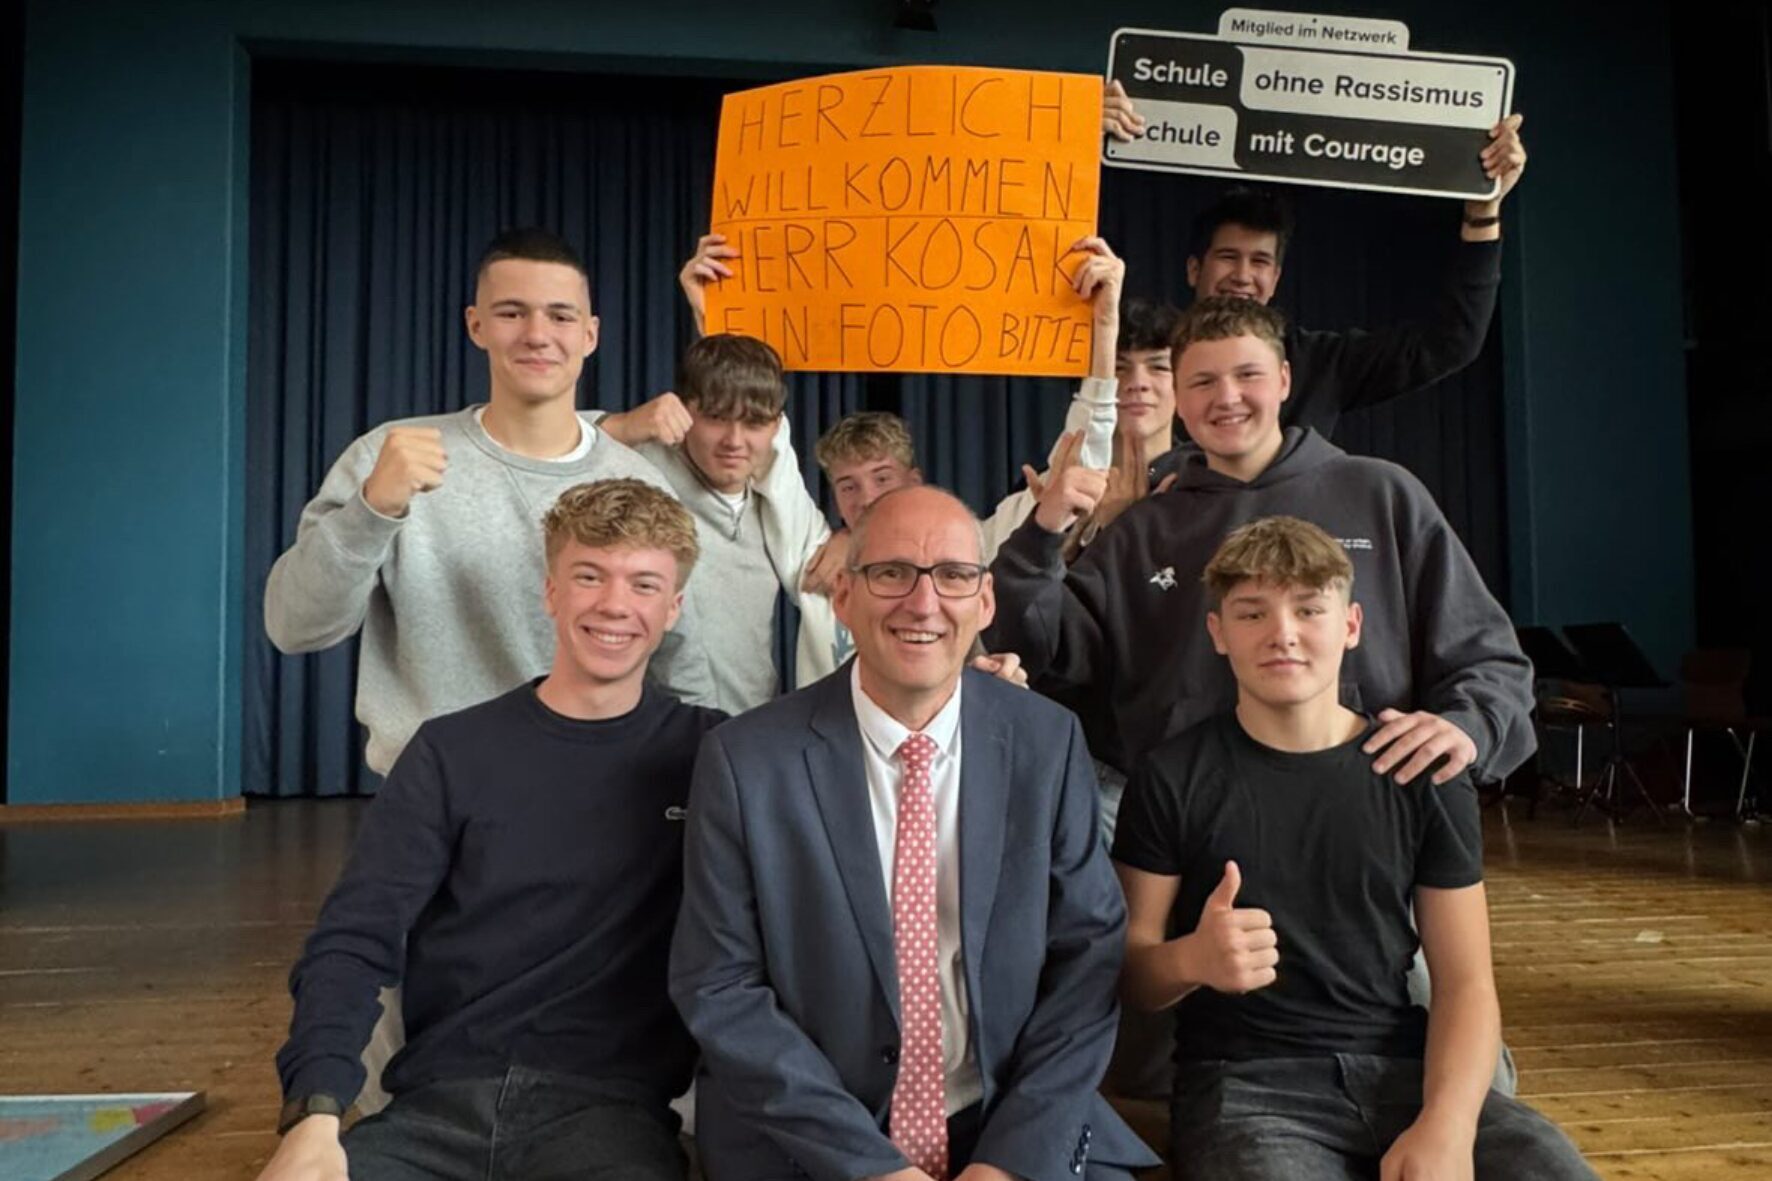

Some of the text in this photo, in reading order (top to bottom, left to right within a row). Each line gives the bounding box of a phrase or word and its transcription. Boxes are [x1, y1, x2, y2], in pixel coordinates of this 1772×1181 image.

[1231, 19, 1397, 45] Mitglied im Netzwerk
[1133, 57, 1484, 108] Schule ohne Rassismus
[738, 74, 1064, 156] HERZLICH
[1133, 121, 1425, 170] chule mit Courage
[723, 155, 1074, 220] WILLKOMMEN
[840, 303, 982, 368] FOTO
[999, 312, 1090, 364] BITTE
